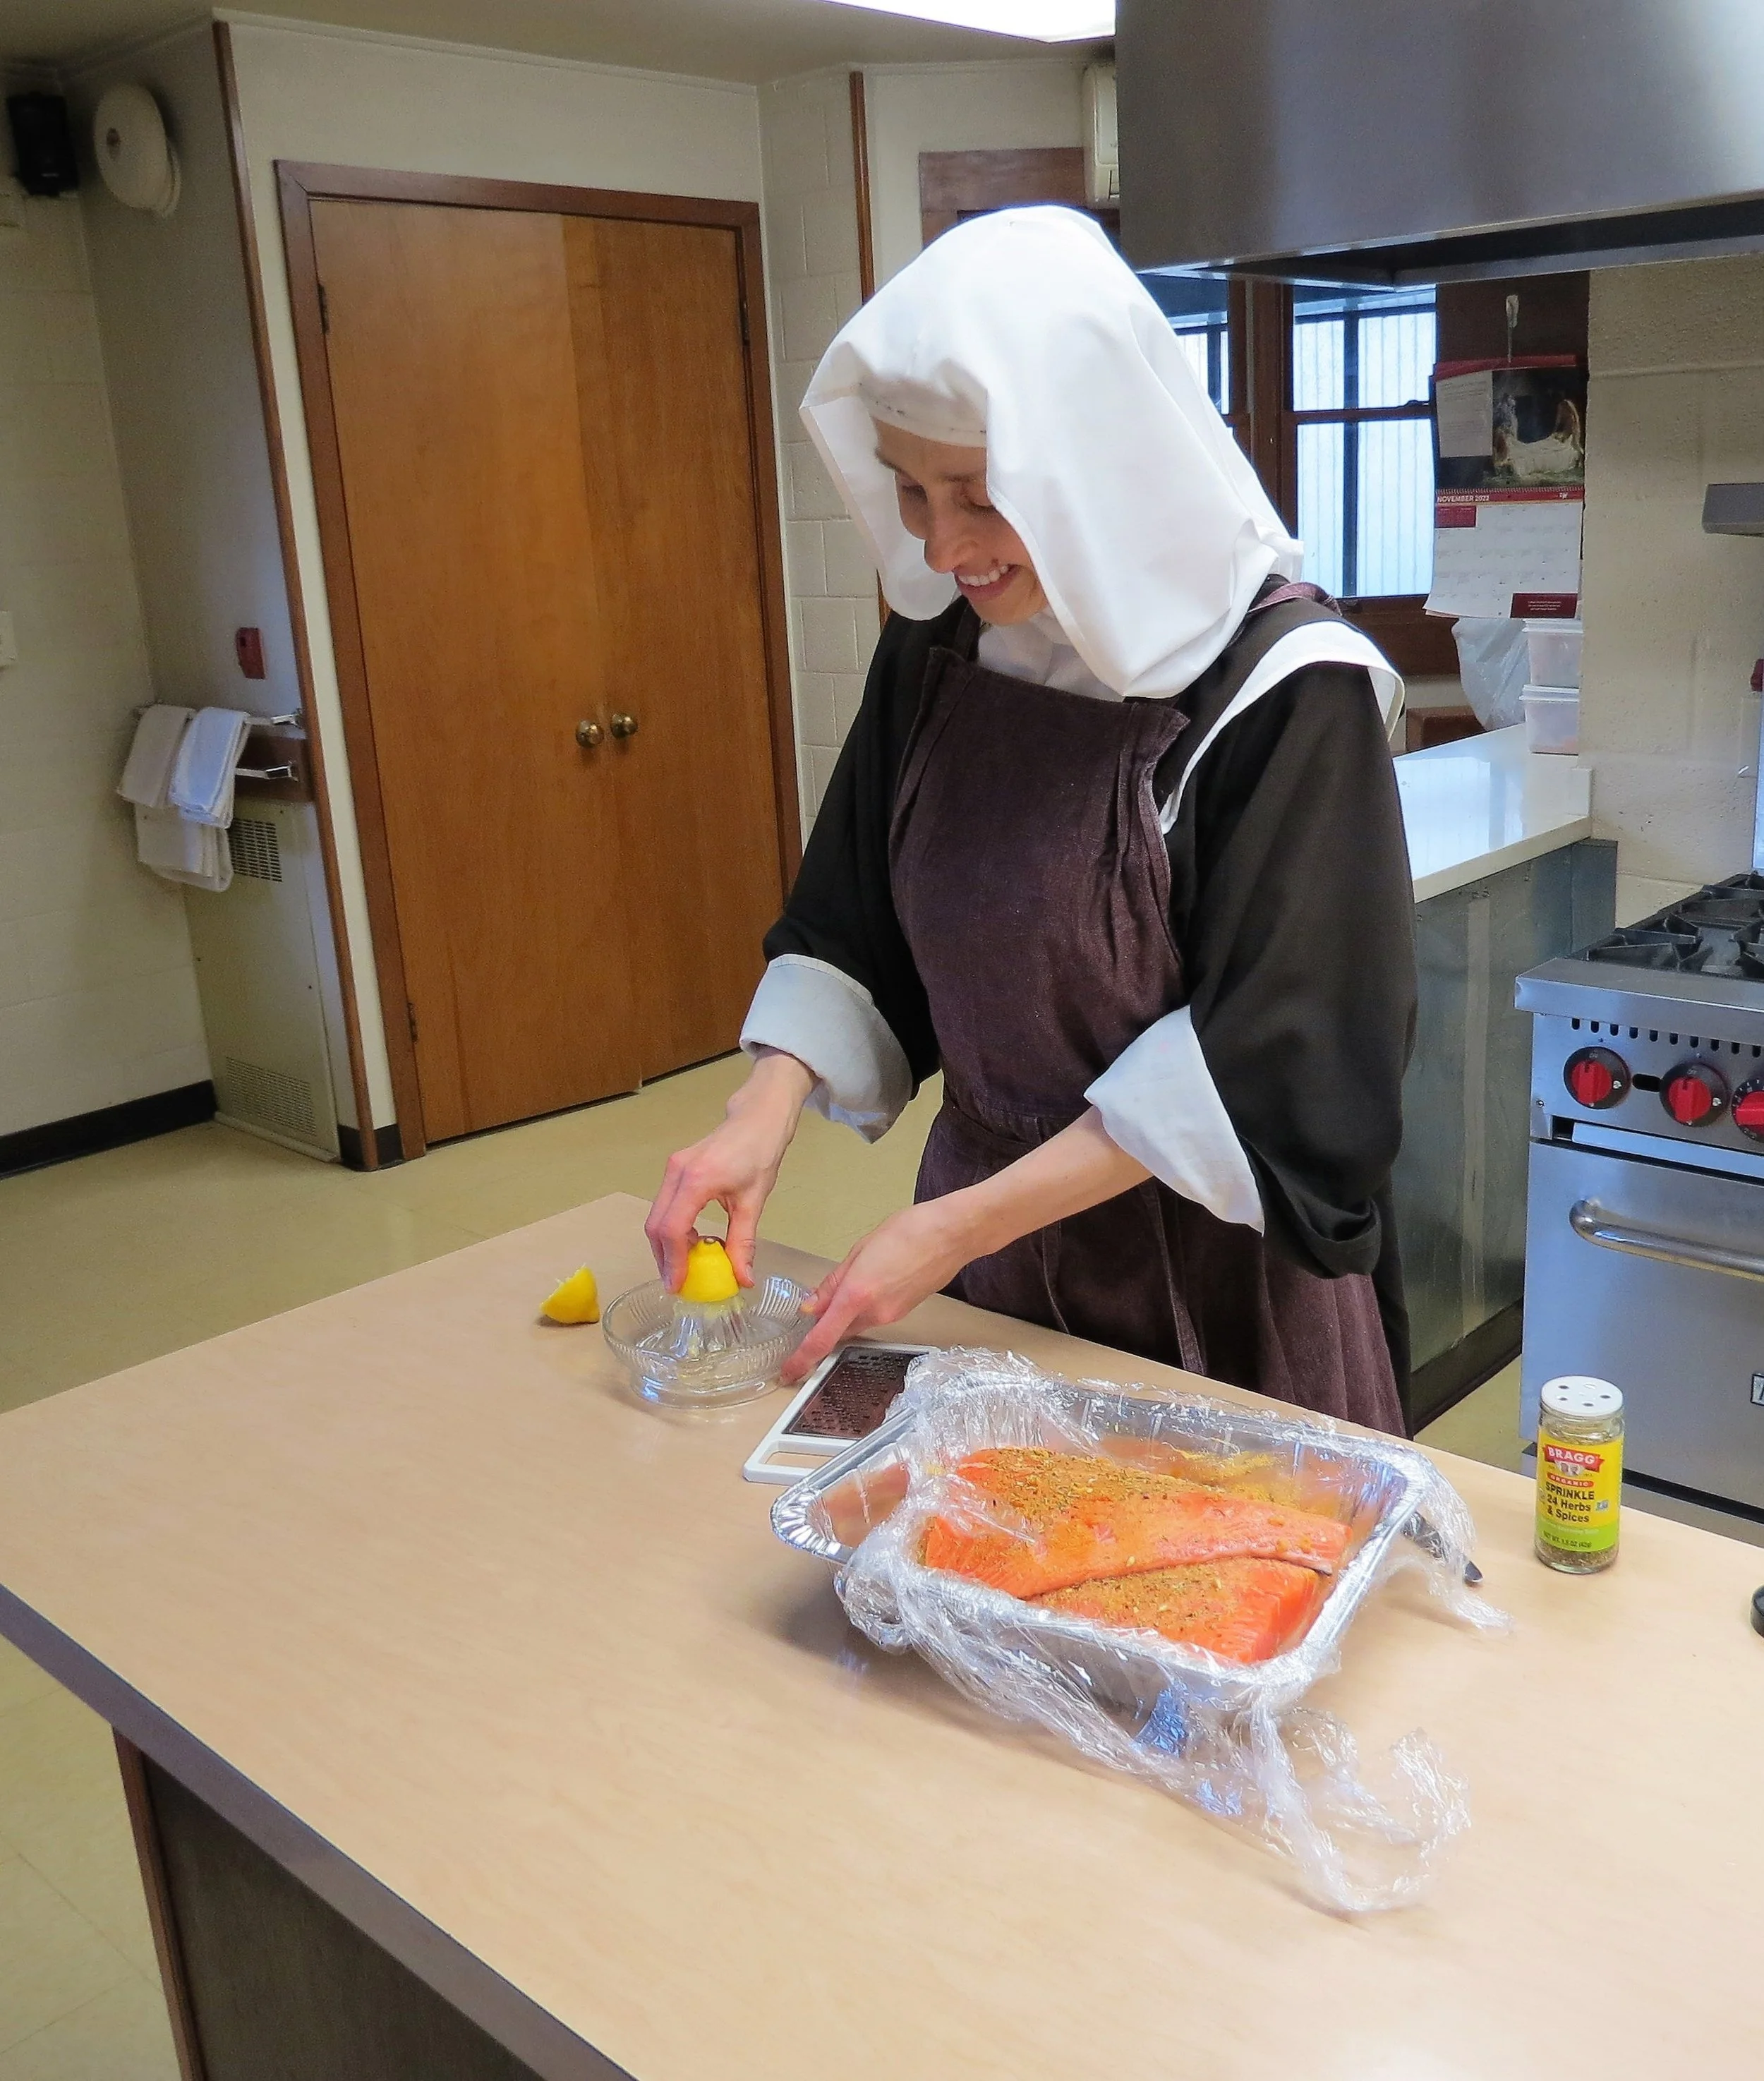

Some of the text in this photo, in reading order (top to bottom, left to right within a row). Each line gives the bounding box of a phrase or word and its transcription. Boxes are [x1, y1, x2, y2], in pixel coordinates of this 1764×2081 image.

[1437, 495, 1474, 503] NOVEMBER
[1547, 1446, 1595, 1465] BRAGG
[1550, 1475, 1588, 1487] ORGANIC
[1545, 1481, 1595, 1500] SPRINKLE
[1547, 1494, 1558, 1505] 24
[1561, 1499, 1591, 1512] Herbs
[1547, 1504, 1590, 1523] & Spices
